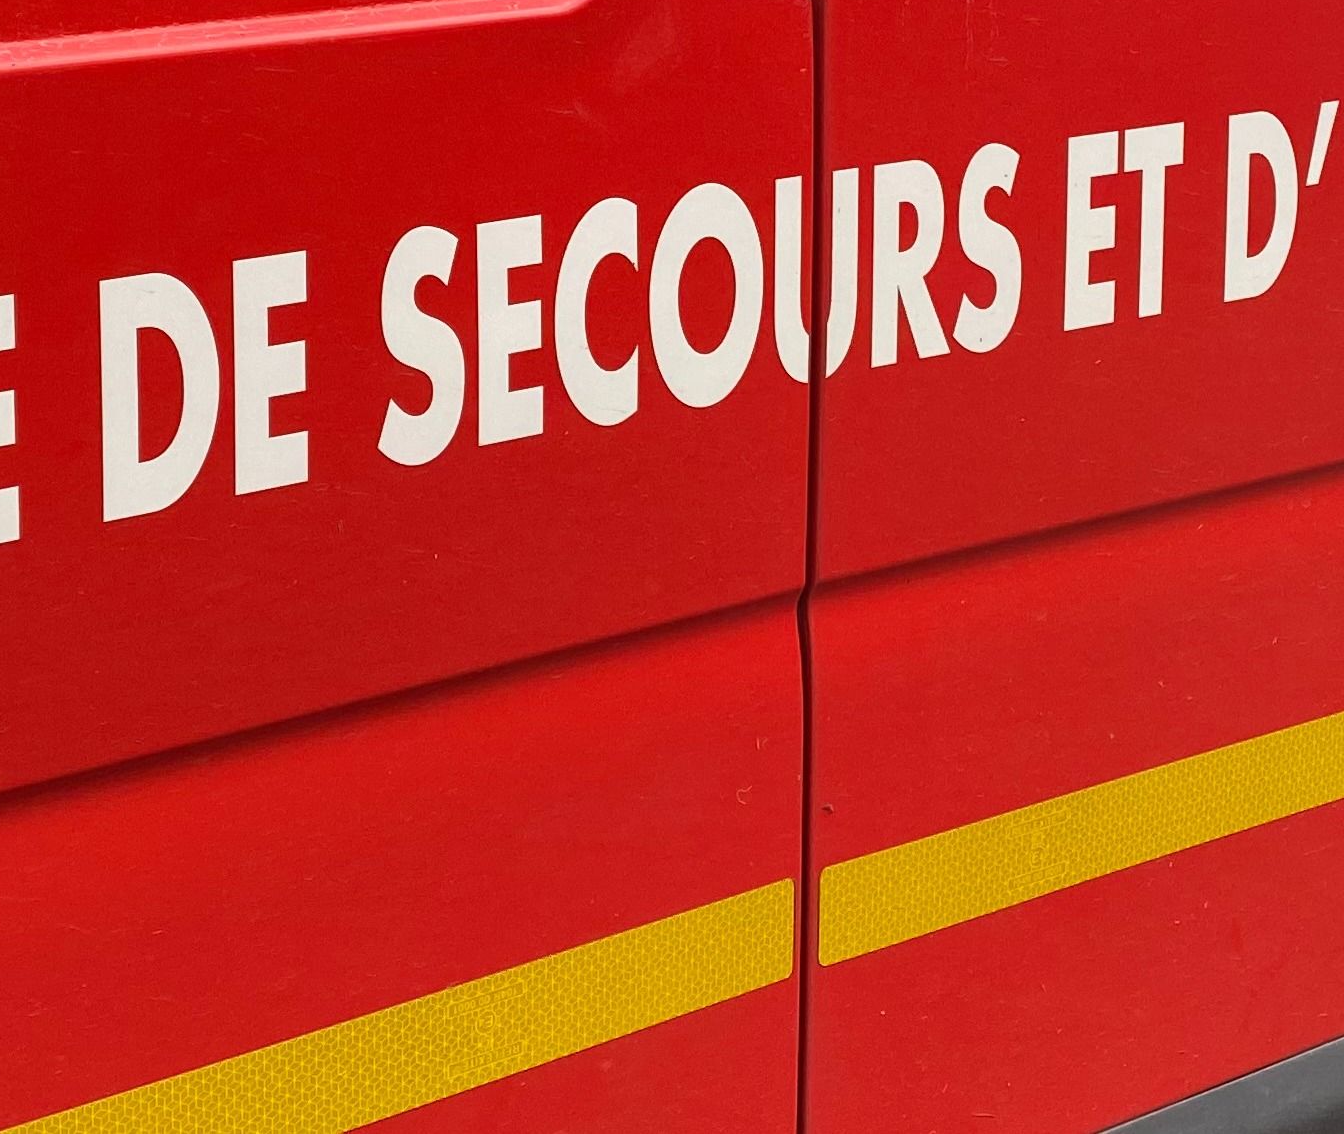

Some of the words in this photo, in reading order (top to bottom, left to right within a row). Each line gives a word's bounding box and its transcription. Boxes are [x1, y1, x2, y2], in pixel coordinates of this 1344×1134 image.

[100, 251, 308, 522] DE
[378, 143, 1021, 465] SECOURS
[1064, 122, 1184, 331] ET
